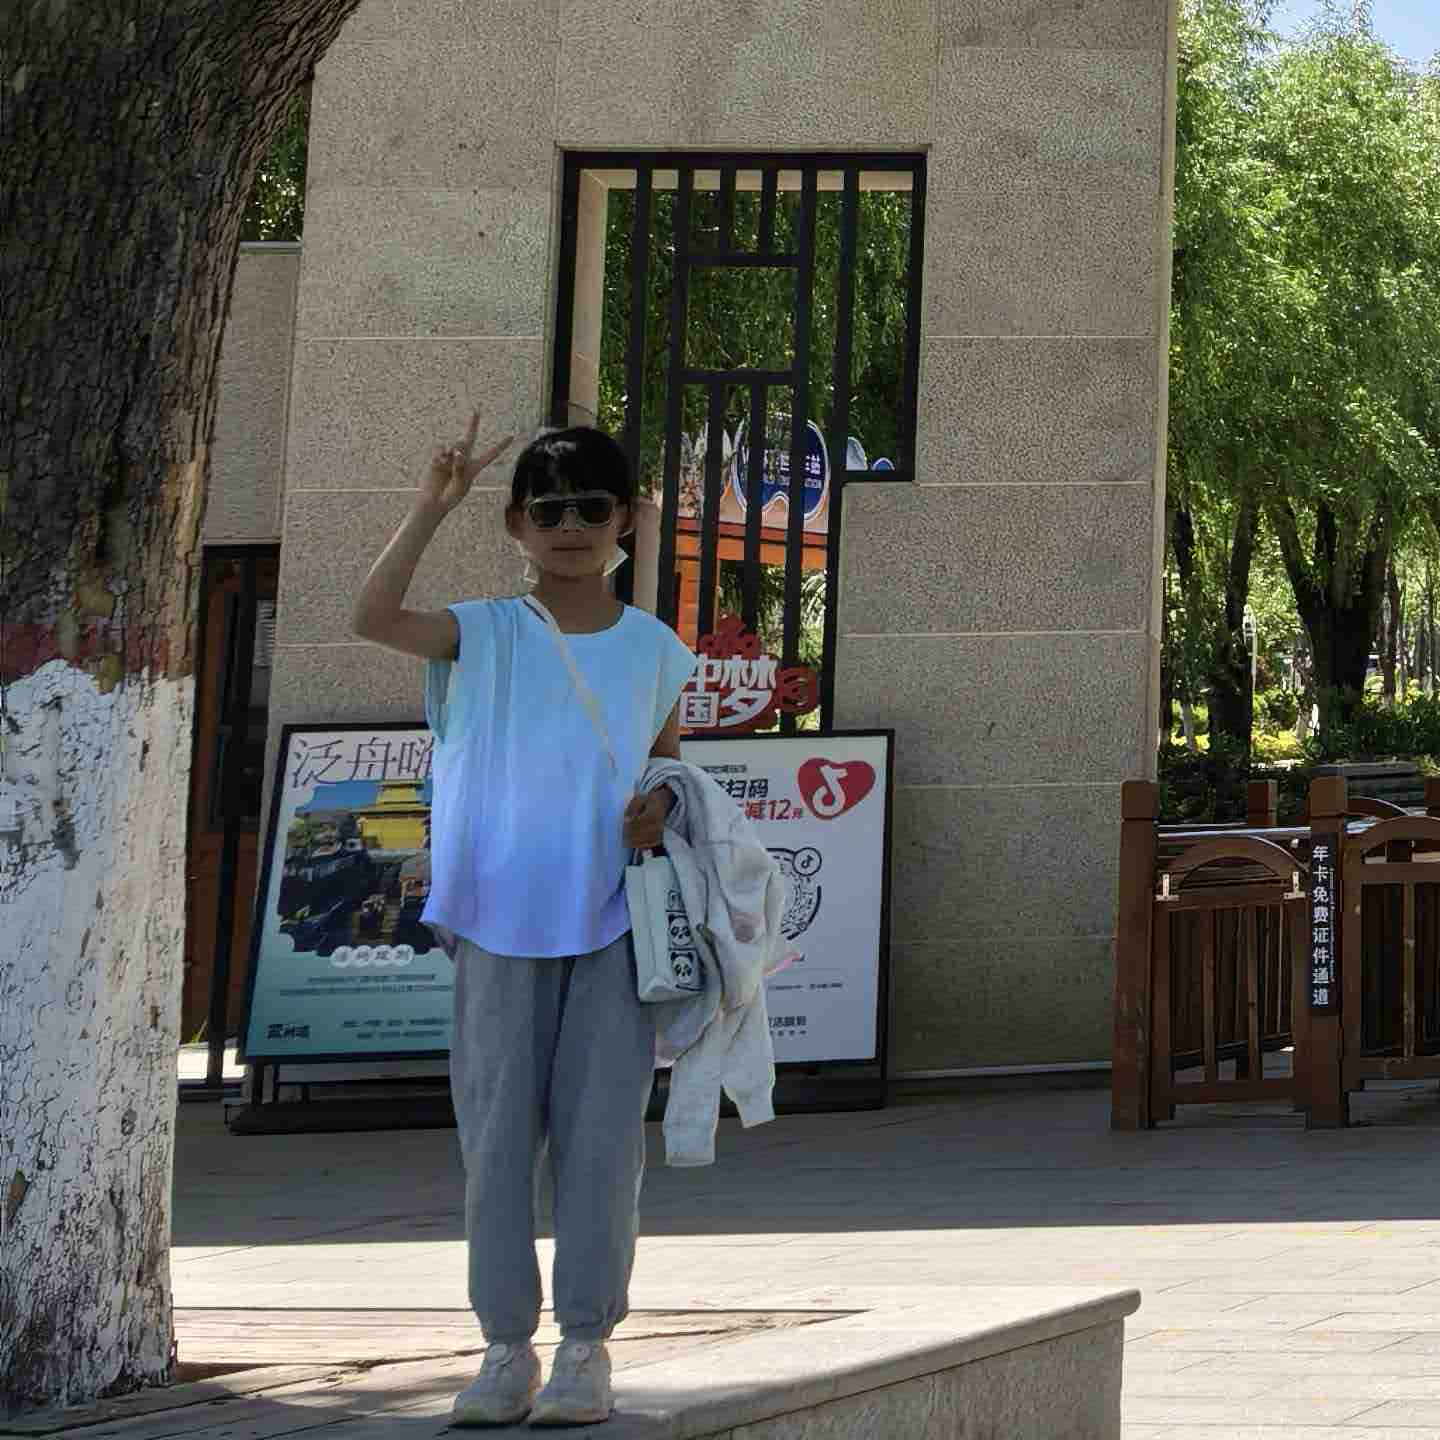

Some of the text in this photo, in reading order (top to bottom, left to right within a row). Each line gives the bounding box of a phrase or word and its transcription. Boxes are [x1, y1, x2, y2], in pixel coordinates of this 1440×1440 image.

[1312, 845, 1330, 1007] 年卡免费证件通道
